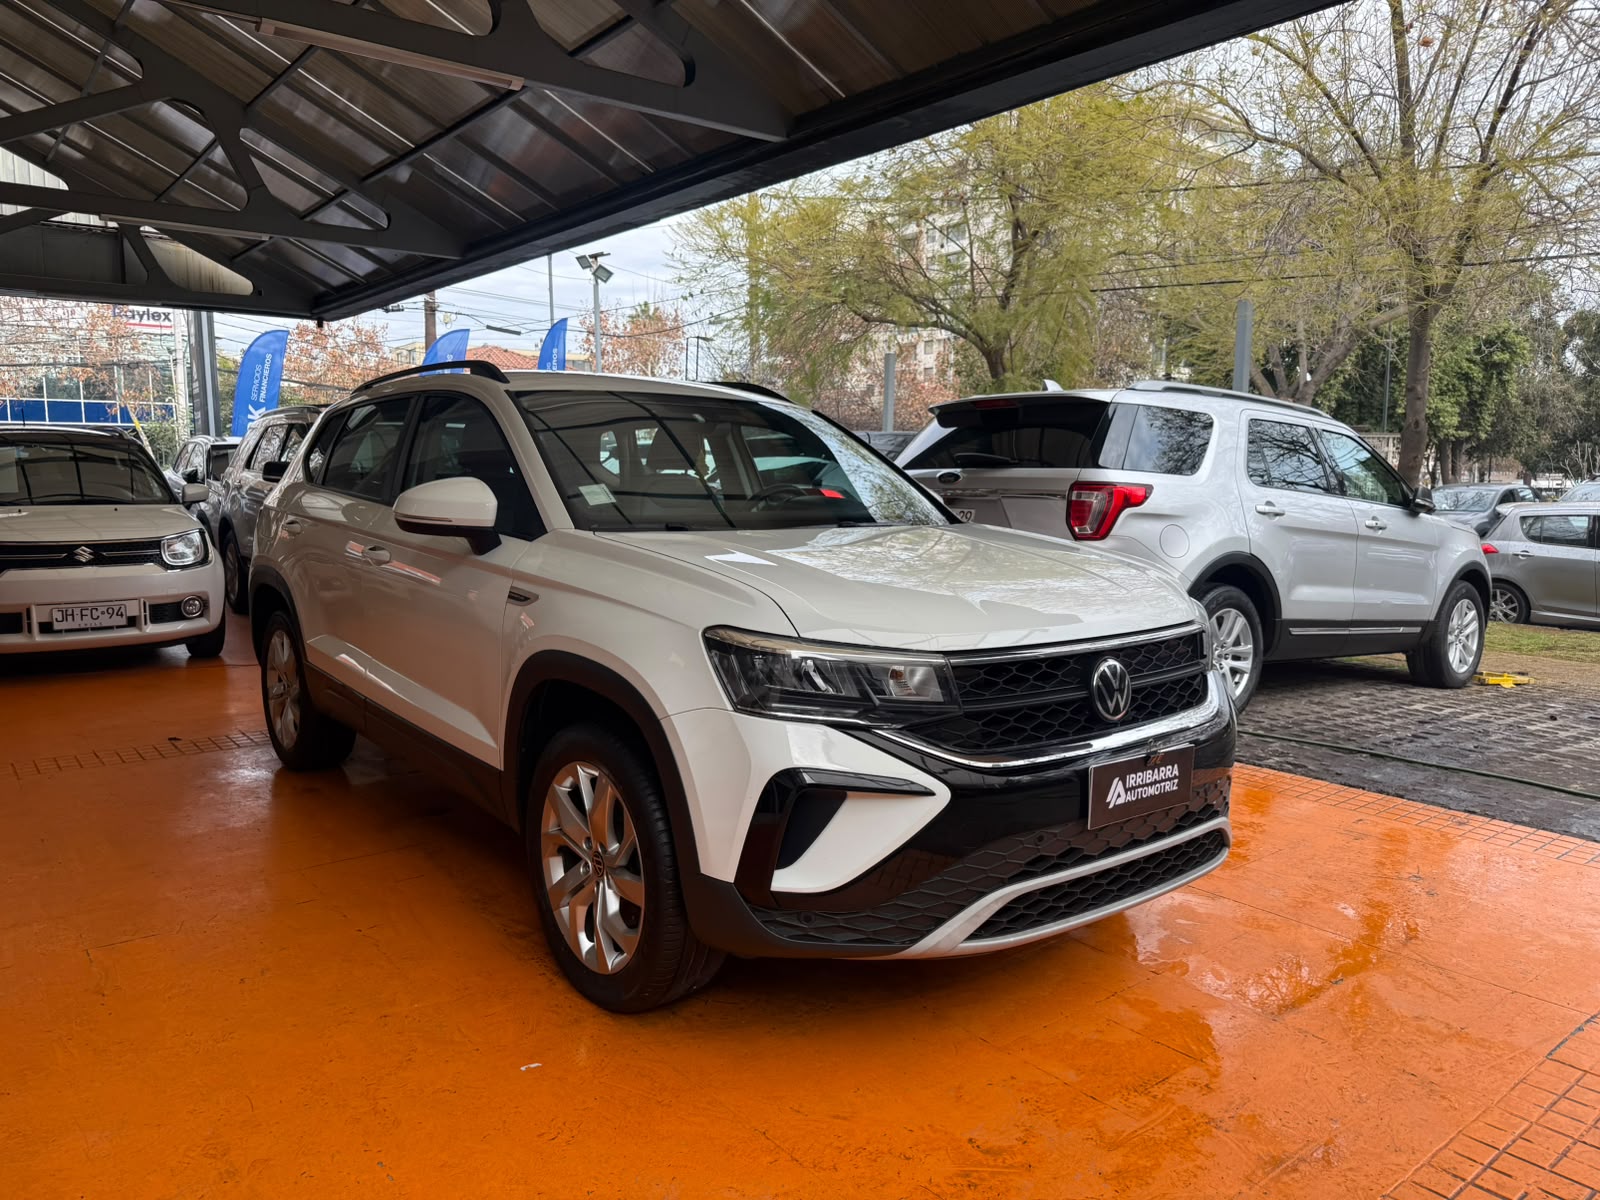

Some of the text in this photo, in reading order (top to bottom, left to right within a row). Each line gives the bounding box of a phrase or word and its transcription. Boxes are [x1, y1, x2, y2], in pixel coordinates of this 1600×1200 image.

[251, 364, 262, 401] SERVICIOS
[259, 353, 272, 402] FINANCIEROS
[1125, 779, 1179, 803] AUTOMOTRIZ
[1126, 763, 1179, 788] IRRIBARRA
